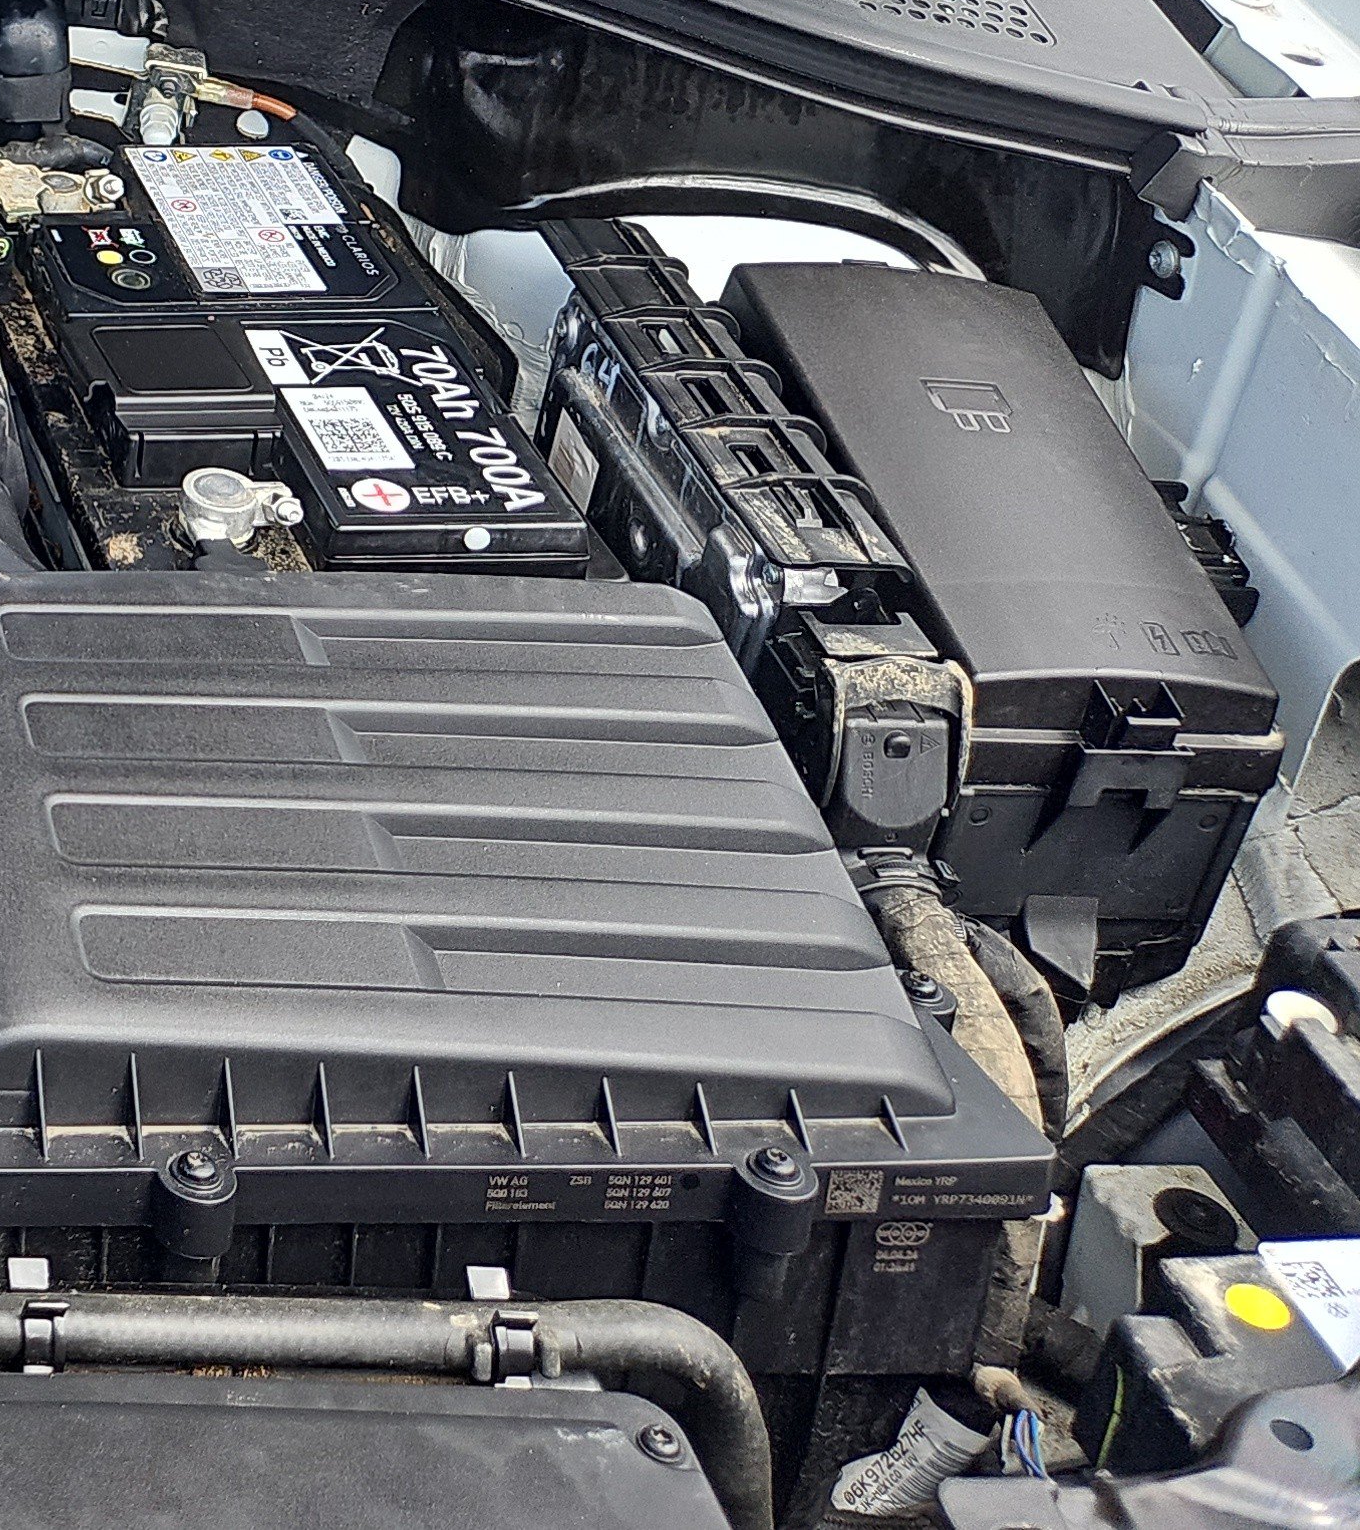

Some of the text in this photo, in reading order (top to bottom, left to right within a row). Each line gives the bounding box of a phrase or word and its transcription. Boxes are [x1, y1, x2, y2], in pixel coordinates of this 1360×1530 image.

[341, 234, 380, 277] CLARIOS
[258, 346, 289, 368] Pb
[399, 344, 547, 513] 70Ah 700A
[410, 486, 491, 506] EFB+
[862, 751, 874, 798] BOSCH
[489, 1176, 508, 1186] VW
[510, 1176, 529, 1186] AG
[634, 1175, 652, 1185] 129
[895, 1176, 958, 1187] Mexico YRP
[632, 1188, 651, 1198] 129
[630, 1200, 649, 1210] 129
